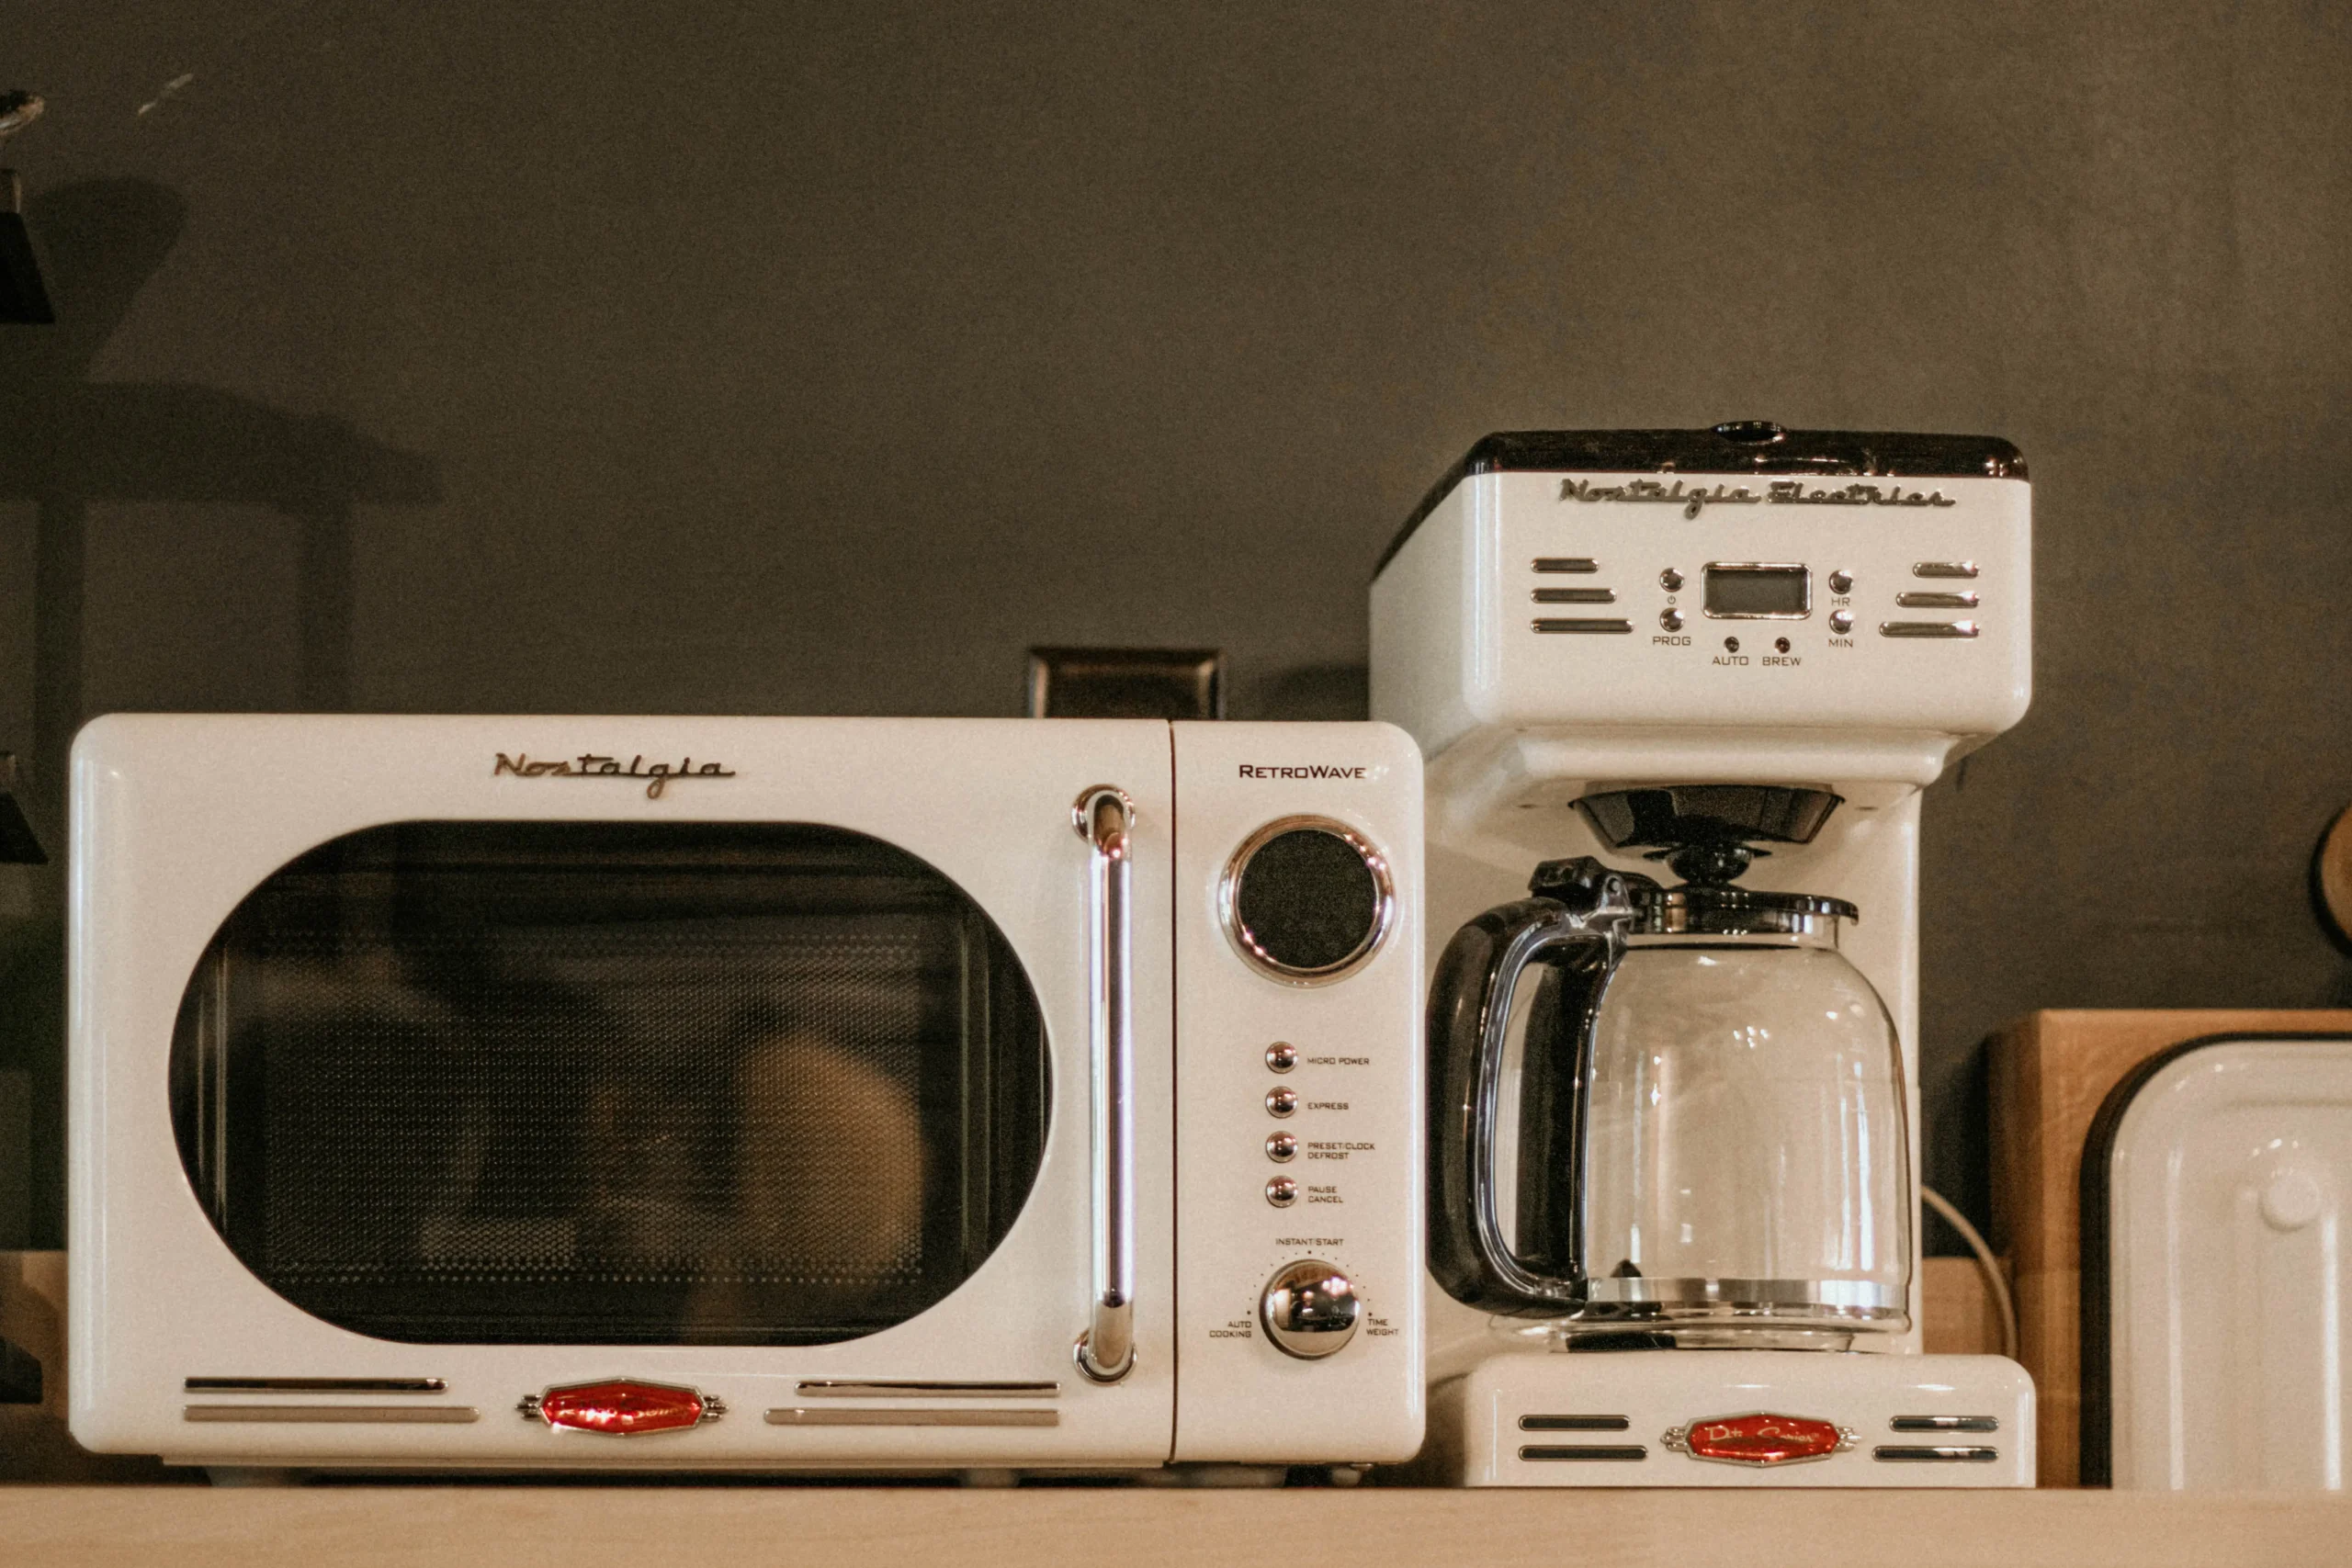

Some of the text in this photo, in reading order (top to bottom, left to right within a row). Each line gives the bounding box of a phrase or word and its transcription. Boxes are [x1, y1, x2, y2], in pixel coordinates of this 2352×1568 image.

[1558, 478, 1959, 521] Nostalgia Electrics
[1830, 596, 1851, 607] HR
[1652, 636, 1691, 647] PROG
[1828, 637, 1854, 649] MIN
[1712, 655, 1802, 667] AUTO BREW
[493, 752, 737, 800] Nostalgia
[1306, 1056, 1370, 1066] MICRO POWER
[1306, 1101, 1350, 1111] EXPRESS
[1306, 1151, 1350, 1160] DEFROST
[1307, 1185, 1338, 1195] PAUSE
[1307, 1195, 1344, 1204] CANCEL
[1227, 1320, 1253, 1329] AUTO
[1367, 1317, 1388, 1326] TIME
[1209, 1329, 1252, 1339] COOKING
[1365, 1327, 1399, 1337] WEIGHT
